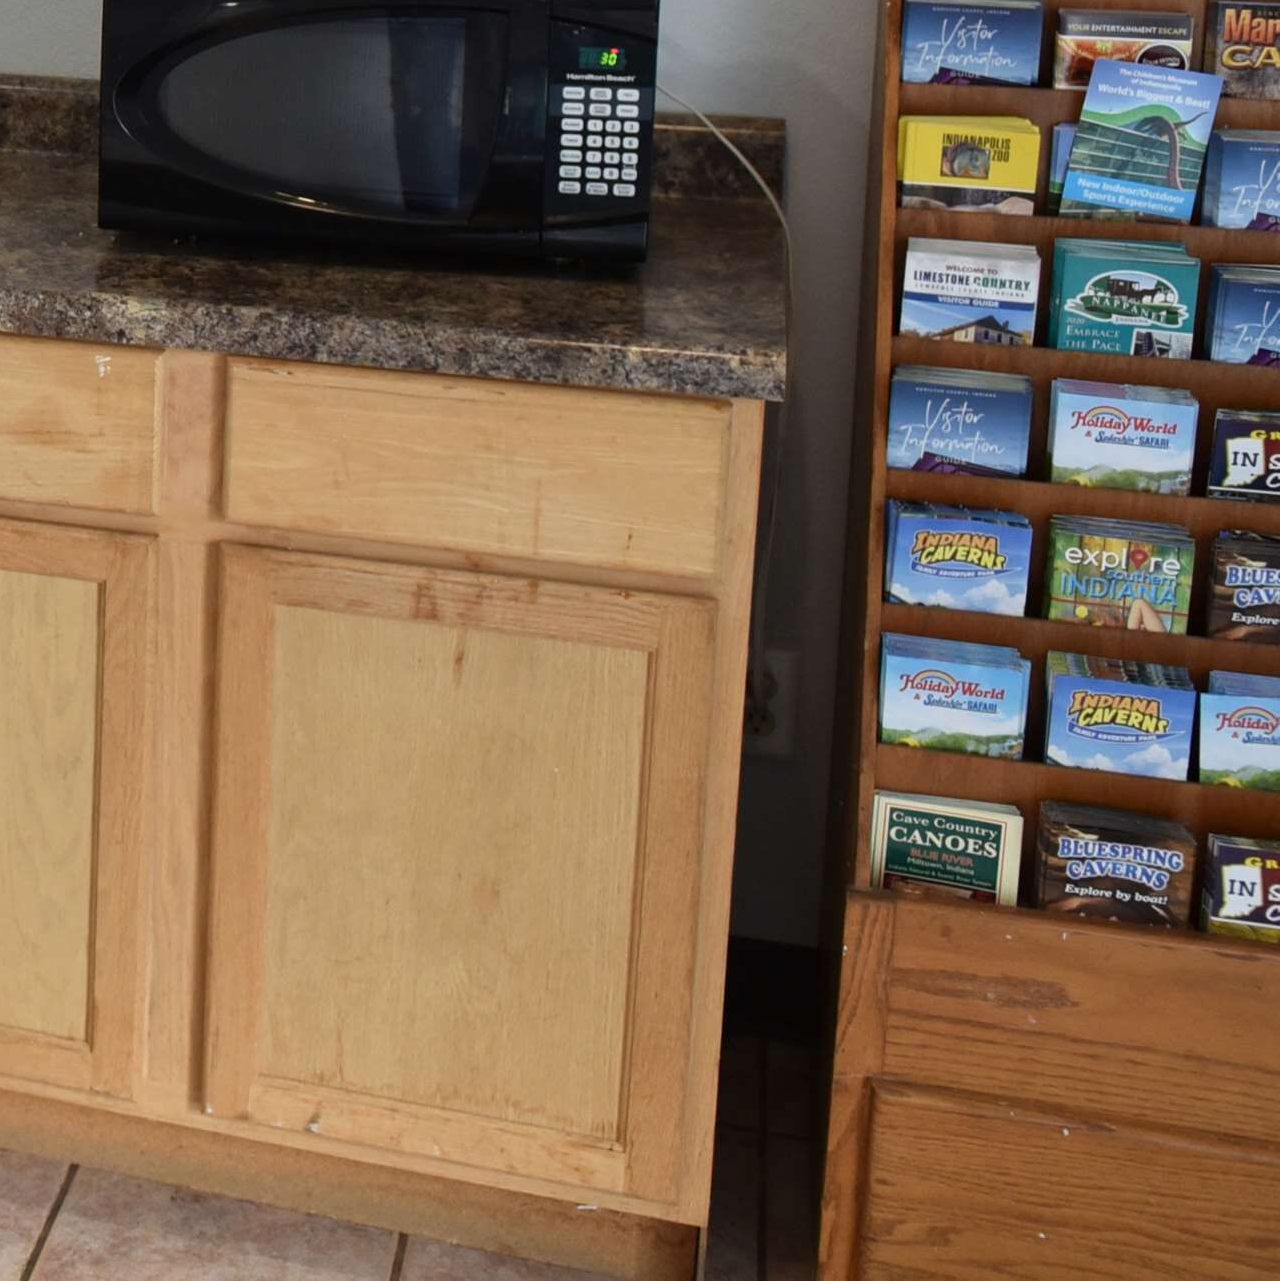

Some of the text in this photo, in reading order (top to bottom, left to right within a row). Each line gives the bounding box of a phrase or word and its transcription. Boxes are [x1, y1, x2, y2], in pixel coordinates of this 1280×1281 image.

[1068, 23, 1188, 36] YOUR ENTERTAINMENT ESCAPE
[600, 52, 618, 66] 30
[566, 73, 636, 83] Hamilton Beach
[1097, 83, 1211, 109] World's Biggest & Best!
[943, 133, 1011, 149] INDIANAPOLIS
[992, 150, 1010, 163] ZOO
[1077, 176, 1100, 189] New
[1083, 190, 1176, 213] Sports Experience
[946, 264, 985, 275] WELCOME
[914, 270, 1031, 292] LIMESTONE COUNTRY
[937, 295, 999, 308] VISITOR GUIDE
[1092, 295, 1167, 322] NAPPANEE
[1066, 326, 1121, 338] EMBRACE
[1065, 339, 1122, 351] THE PACE
[926, 398, 985, 434] Visitor
[1071, 410, 1177, 435] Holiday World
[1139, 436, 1169, 449] SAFARI
[1230, 451, 1259, 467] IN
[913, 530, 999, 555] INDIANA
[921, 546, 1007, 570] CAVERNS
[1107, 568, 1176, 586] southern
[1061, 573, 1177, 606] INDIANA
[900, 673, 1005, 700] Holiday World
[967, 700, 997, 713] SAFARI
[1069, 691, 1161, 717] INDIANA
[1077, 706, 1170, 734] CAVERNS
[1216, 712, 1280, 735] Holiday
[892, 810, 998, 840] Cave Country
[889, 825, 997, 859] CANOES
[911, 848, 974, 867] BLUE RIVER
[1059, 836, 1184, 872] BLUESPRING
[946, 864, 975, 876] Indiana
[1067, 859, 1170, 891] CAVERNS
[1065, 883, 1168, 906] Explore by boat!
[1227, 879, 1257, 897] IN
